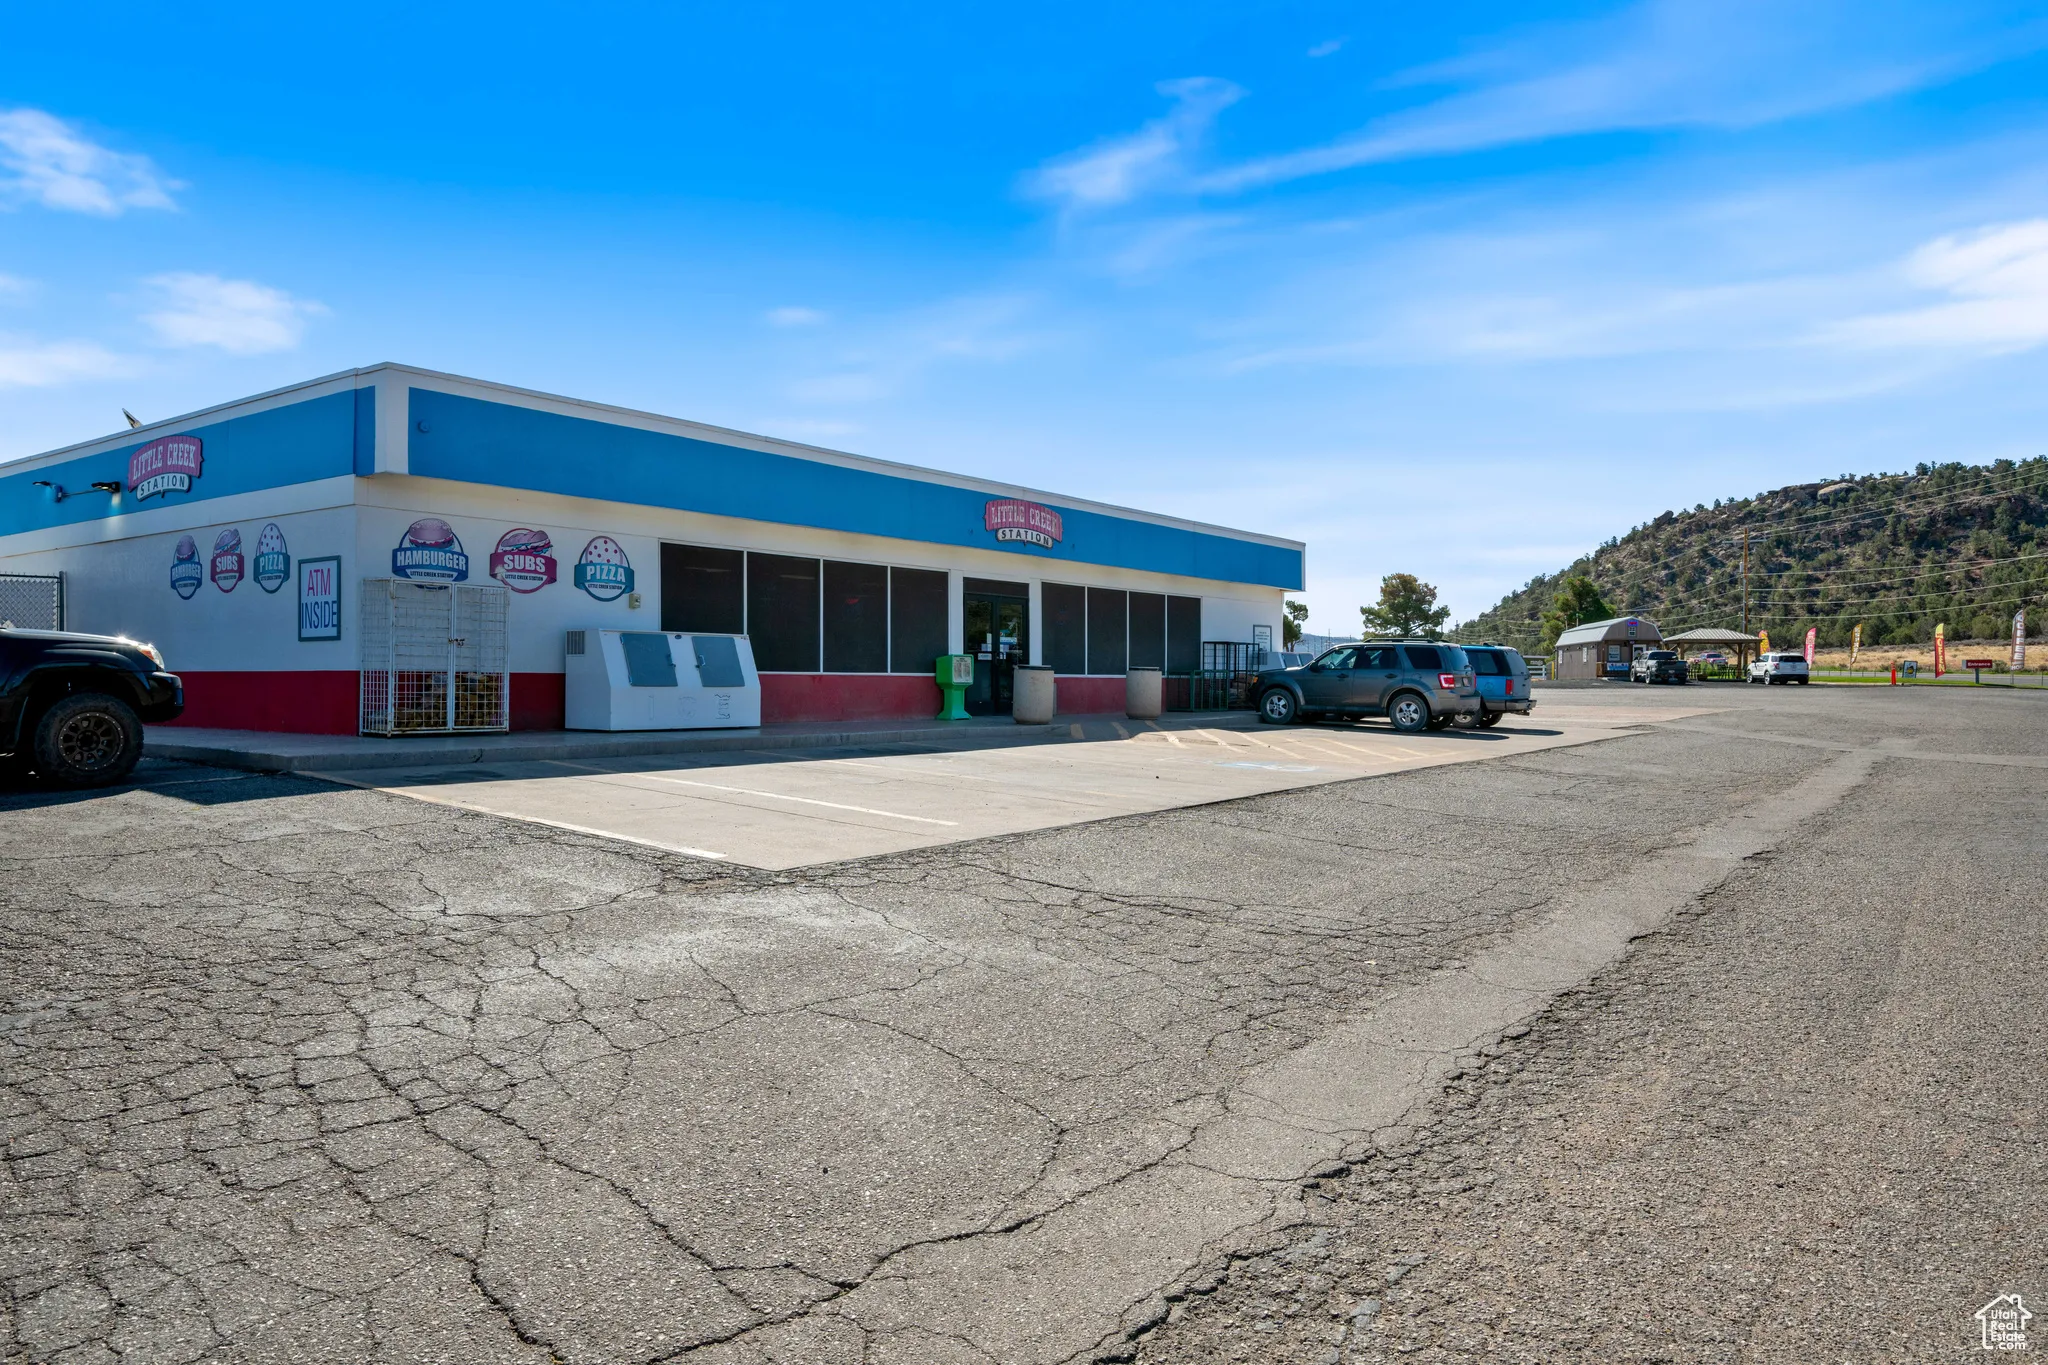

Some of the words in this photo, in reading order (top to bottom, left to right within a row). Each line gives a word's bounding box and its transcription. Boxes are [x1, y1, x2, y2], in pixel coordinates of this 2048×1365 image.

[133, 445, 163, 480] LITTLE
[167, 443, 196, 468] CREEK
[140, 475, 185, 496] STATION
[991, 505, 1025, 524] LITTLE
[1001, 529, 1049, 546] STATION
[216, 555, 238, 572] SUBS
[260, 554, 284, 572] PIZZA
[397, 550, 466, 571] HAMBURGER
[503, 554, 546, 573] SUBS
[307, 567, 331, 596] ATM
[586, 565, 626, 583] PIZZA
[301, 600, 337, 629] INSIDE
[1936, 638, 1946, 673] OPEN
